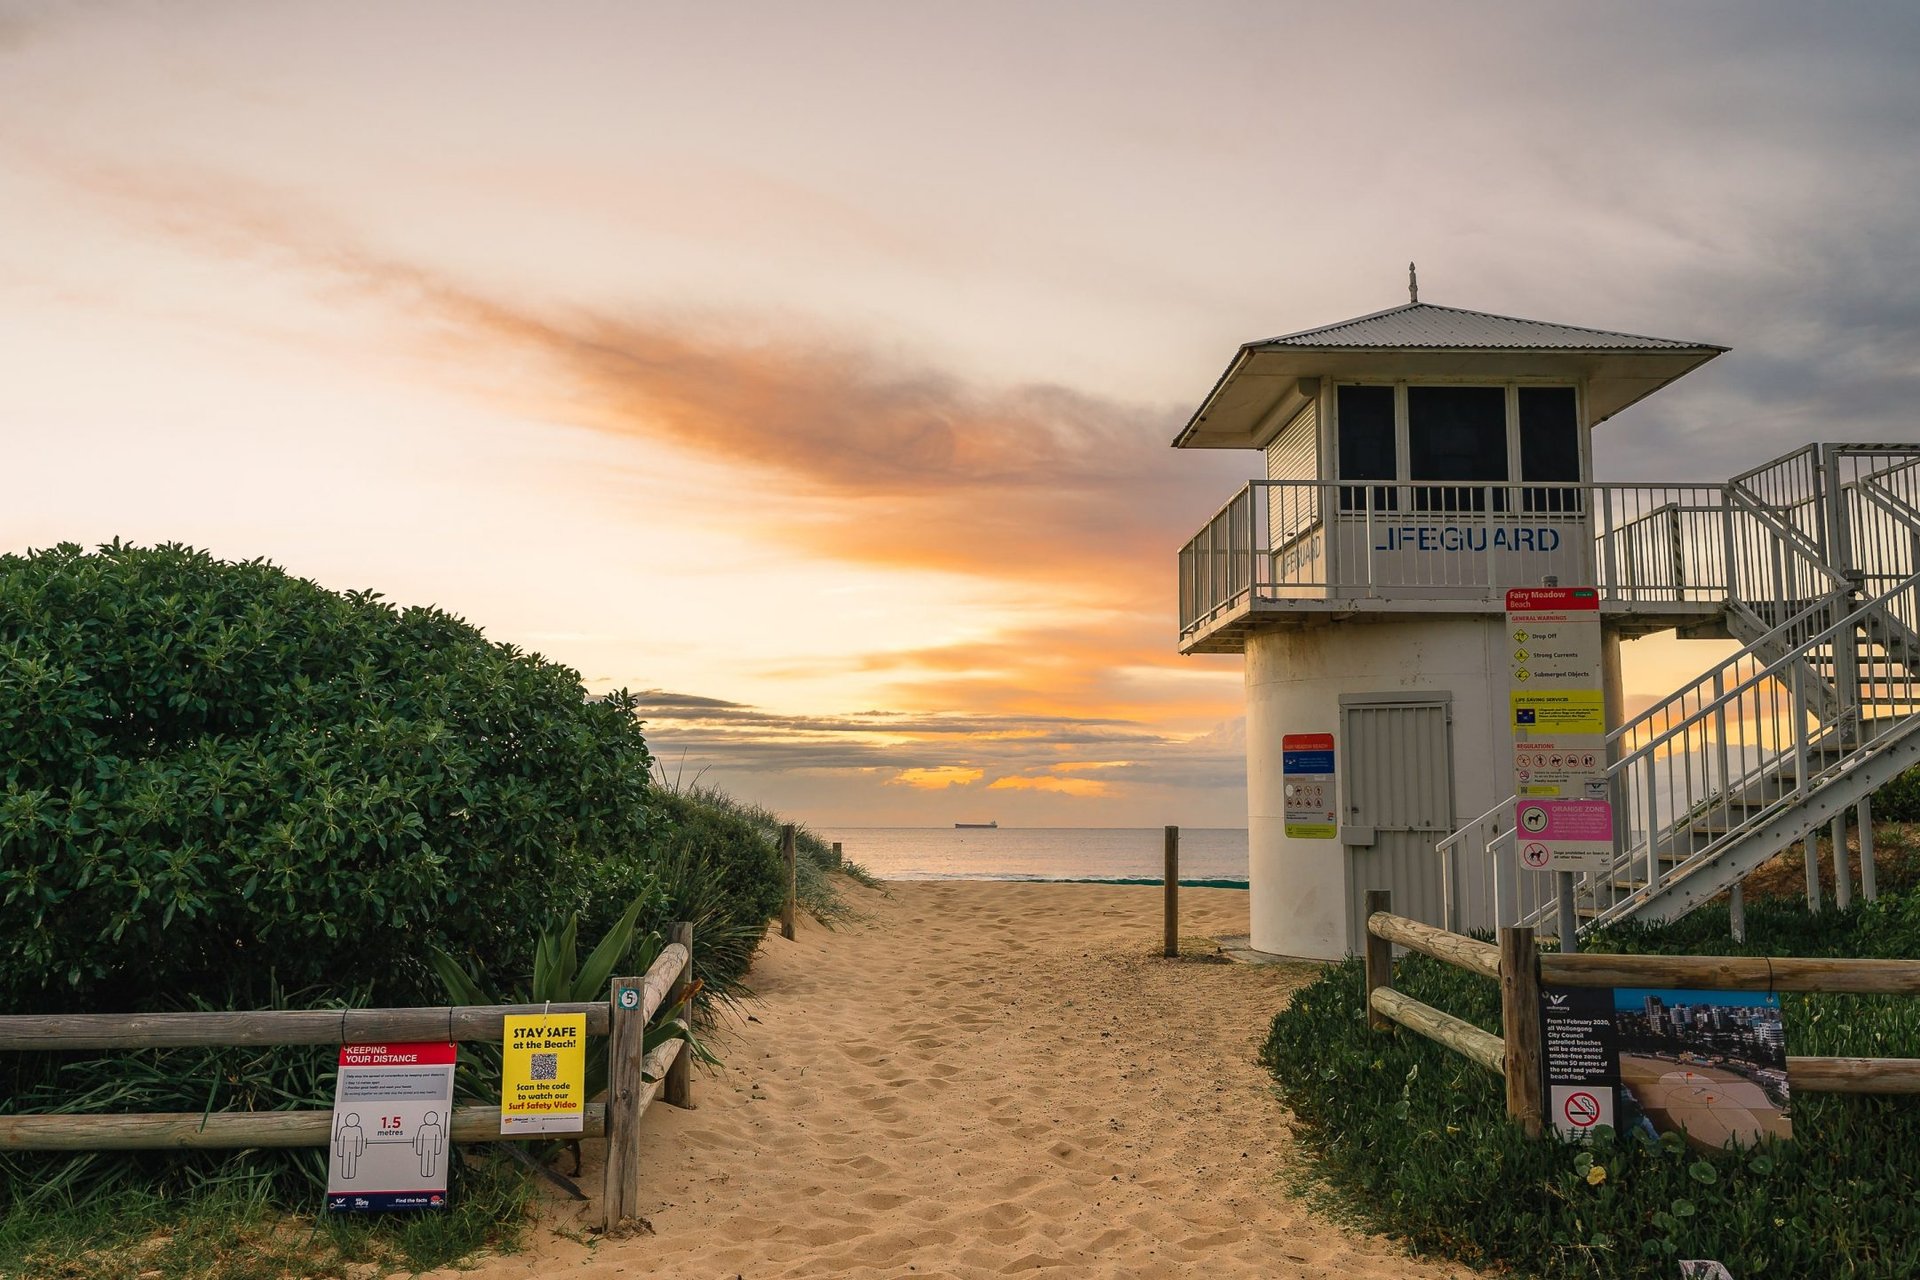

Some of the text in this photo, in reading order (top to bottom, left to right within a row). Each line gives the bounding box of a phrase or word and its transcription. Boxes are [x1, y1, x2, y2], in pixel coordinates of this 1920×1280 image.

[1510, 591, 1529, 600] Fairy
[626, 992, 633, 1004] 5
[514, 1027, 576, 1038] STAY SAFE
[513, 1040, 576, 1049] at the Beach!
[347, 1046, 387, 1054] KEEPING
[346, 1054, 418, 1063] YOUR DISTANCE
[509, 1102, 525, 1110] Surf
[527, 1102, 552, 1110] Safety
[381, 1116, 402, 1128] 1.5
